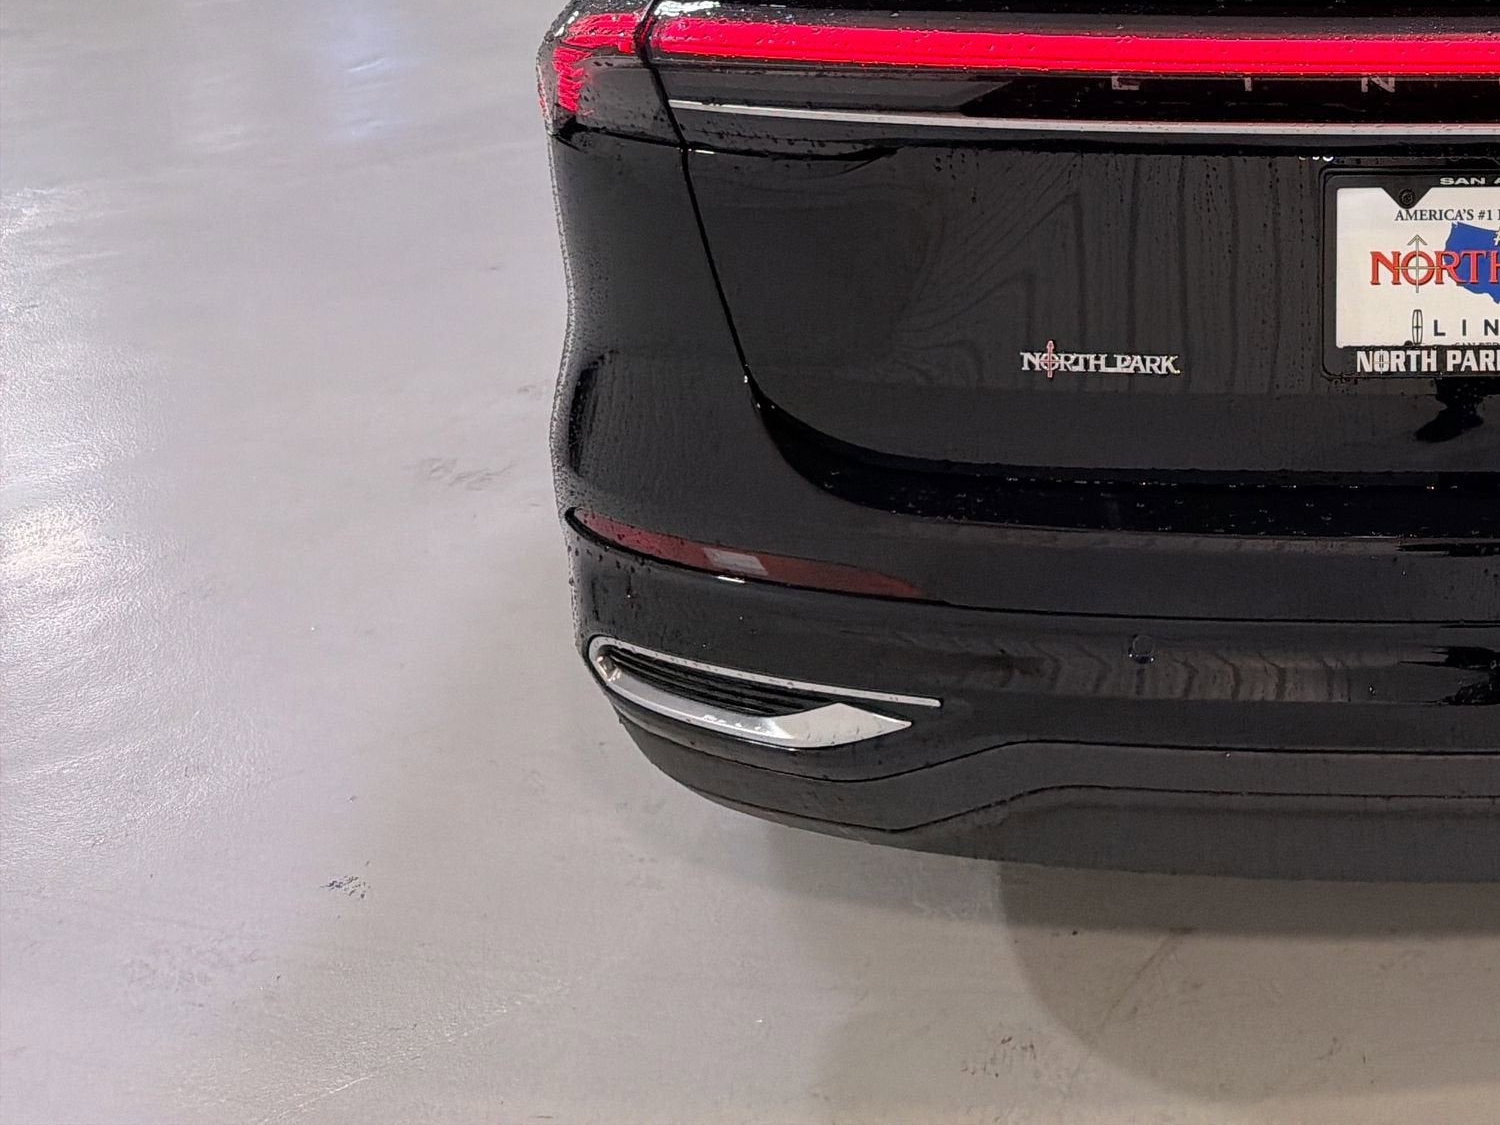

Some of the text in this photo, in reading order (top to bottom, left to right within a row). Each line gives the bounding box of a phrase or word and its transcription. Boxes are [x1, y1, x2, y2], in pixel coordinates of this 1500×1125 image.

[1439, 177, 1486, 186] SAN
[1394, 208, 1475, 221] AMERICA'S
[1477, 208, 1493, 221] #1
[1020, 351, 1181, 375] NORTH PARK
[1356, 349, 1438, 373] NORTH
